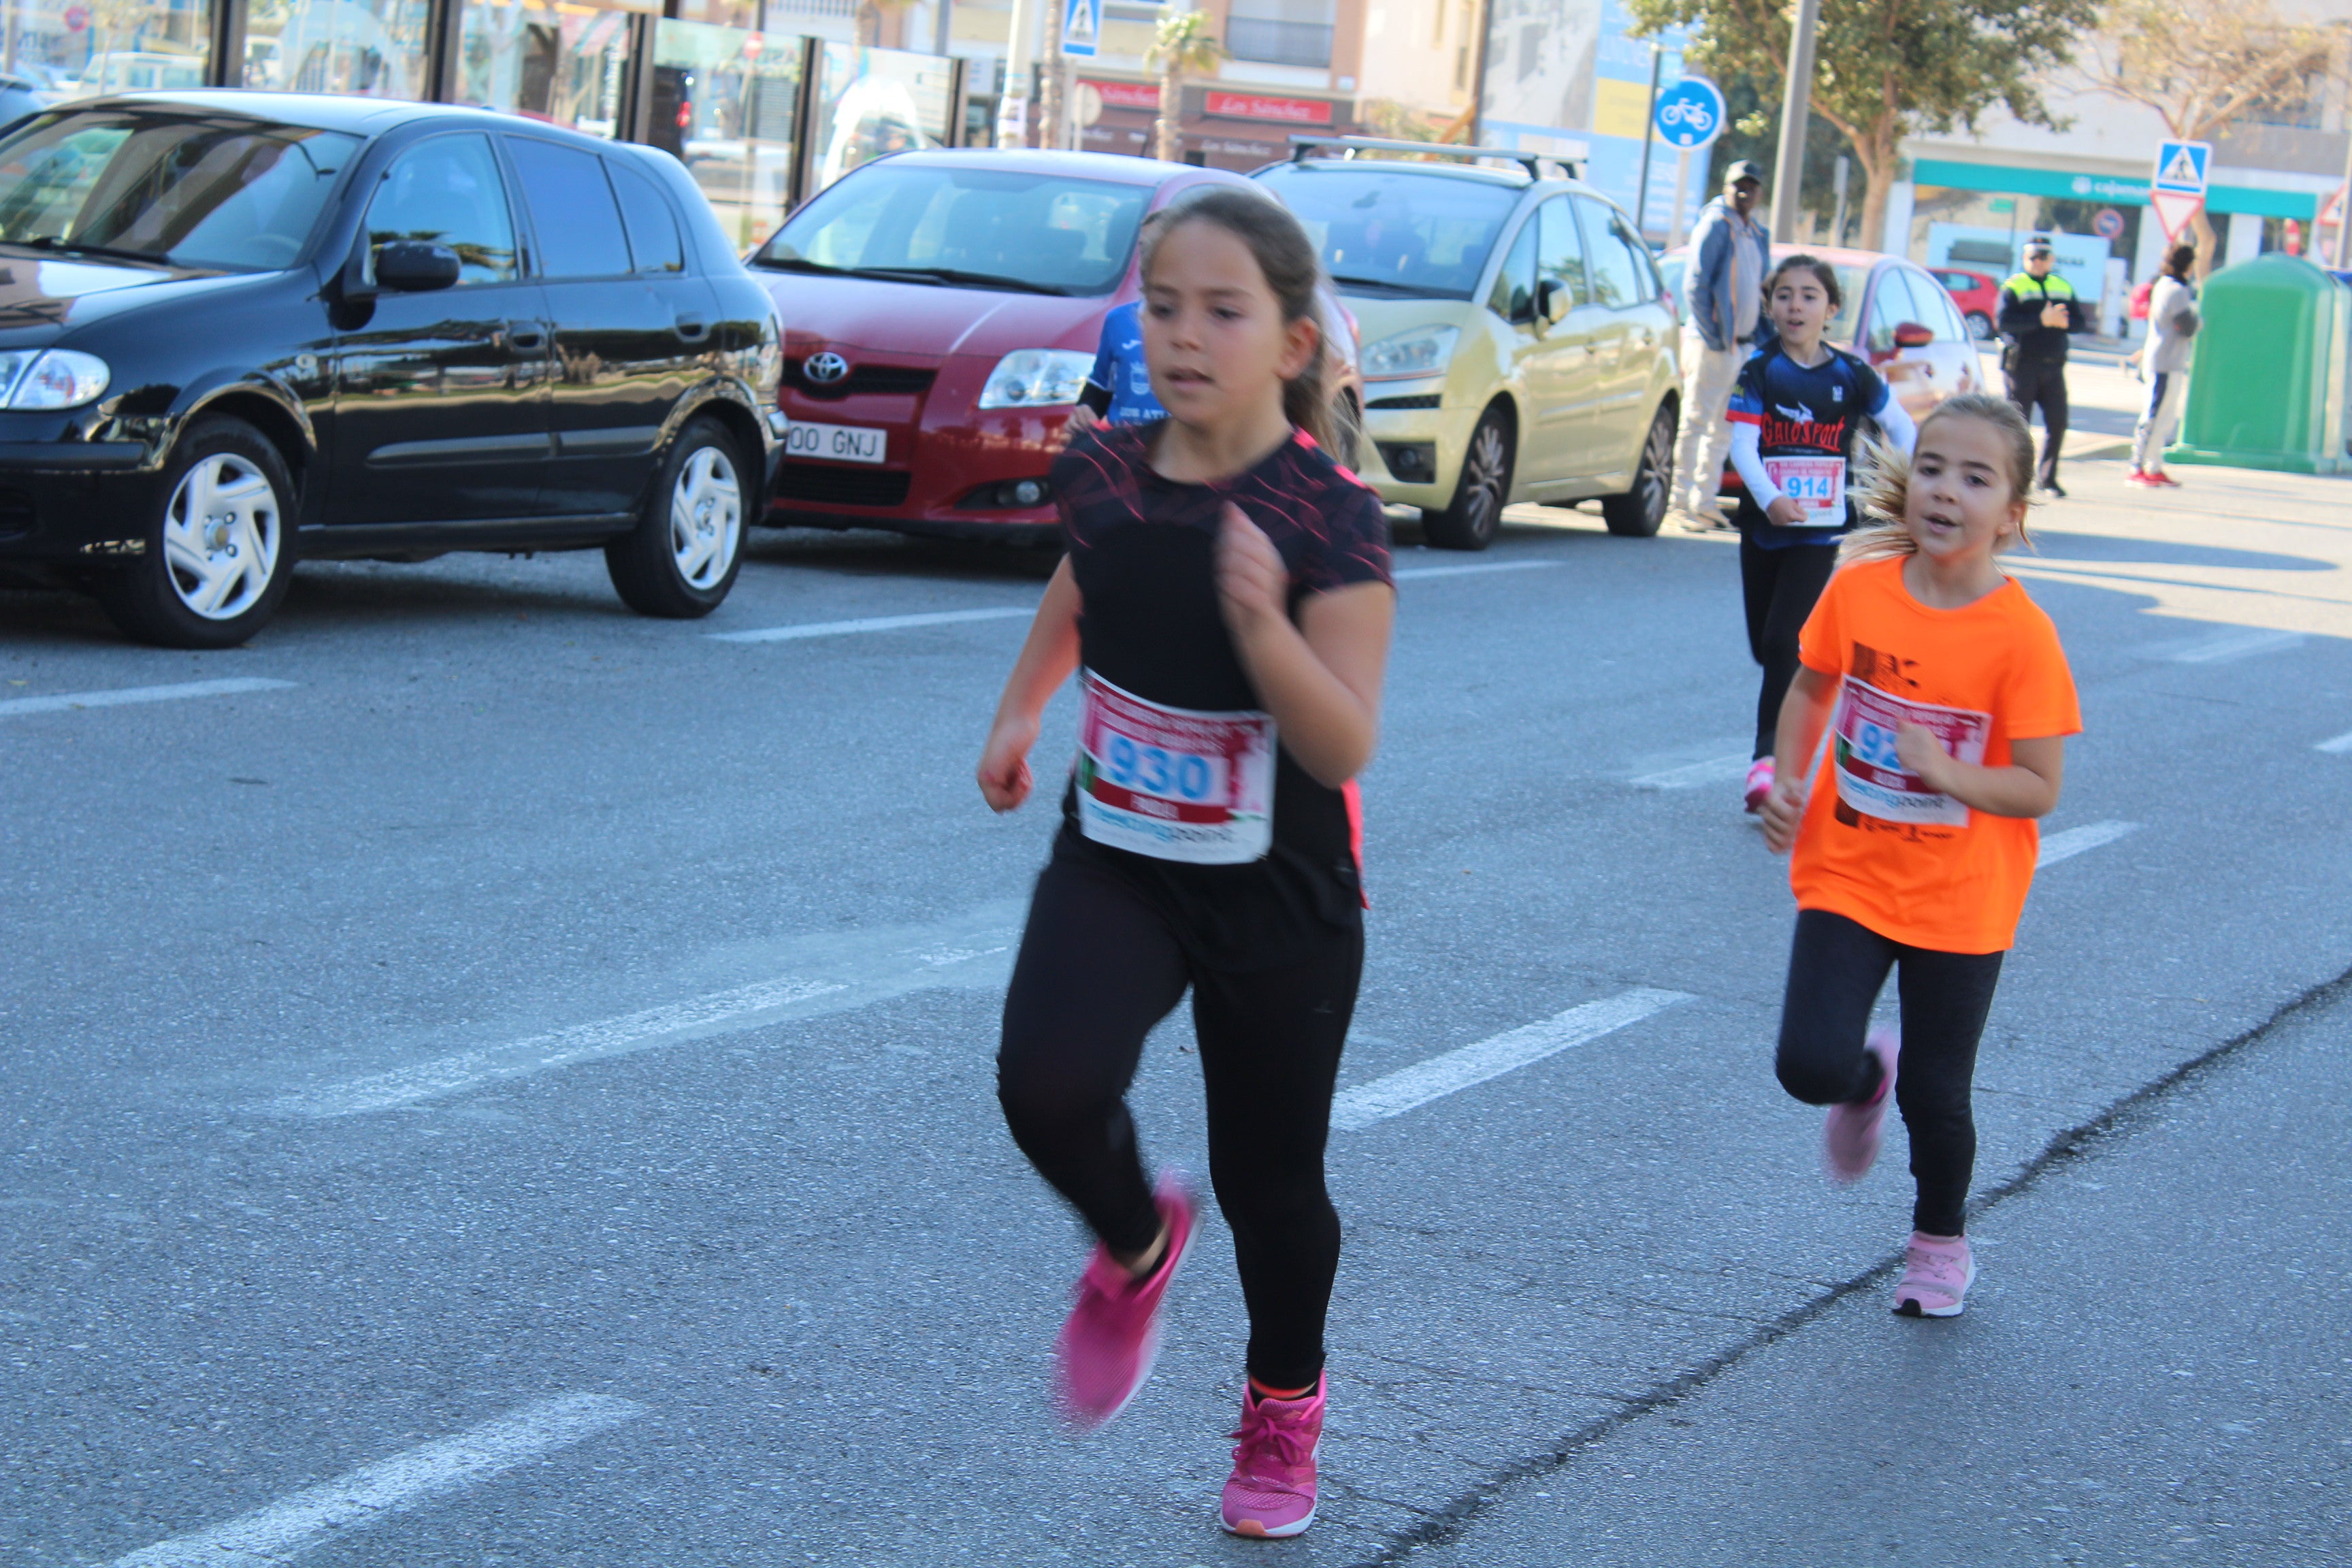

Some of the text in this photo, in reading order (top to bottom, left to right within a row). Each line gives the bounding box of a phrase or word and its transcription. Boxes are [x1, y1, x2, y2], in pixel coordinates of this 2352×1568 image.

[833, 429, 876, 457] GNJ
[1788, 477, 1828, 497] 914
[1108, 734, 1213, 800] 930
